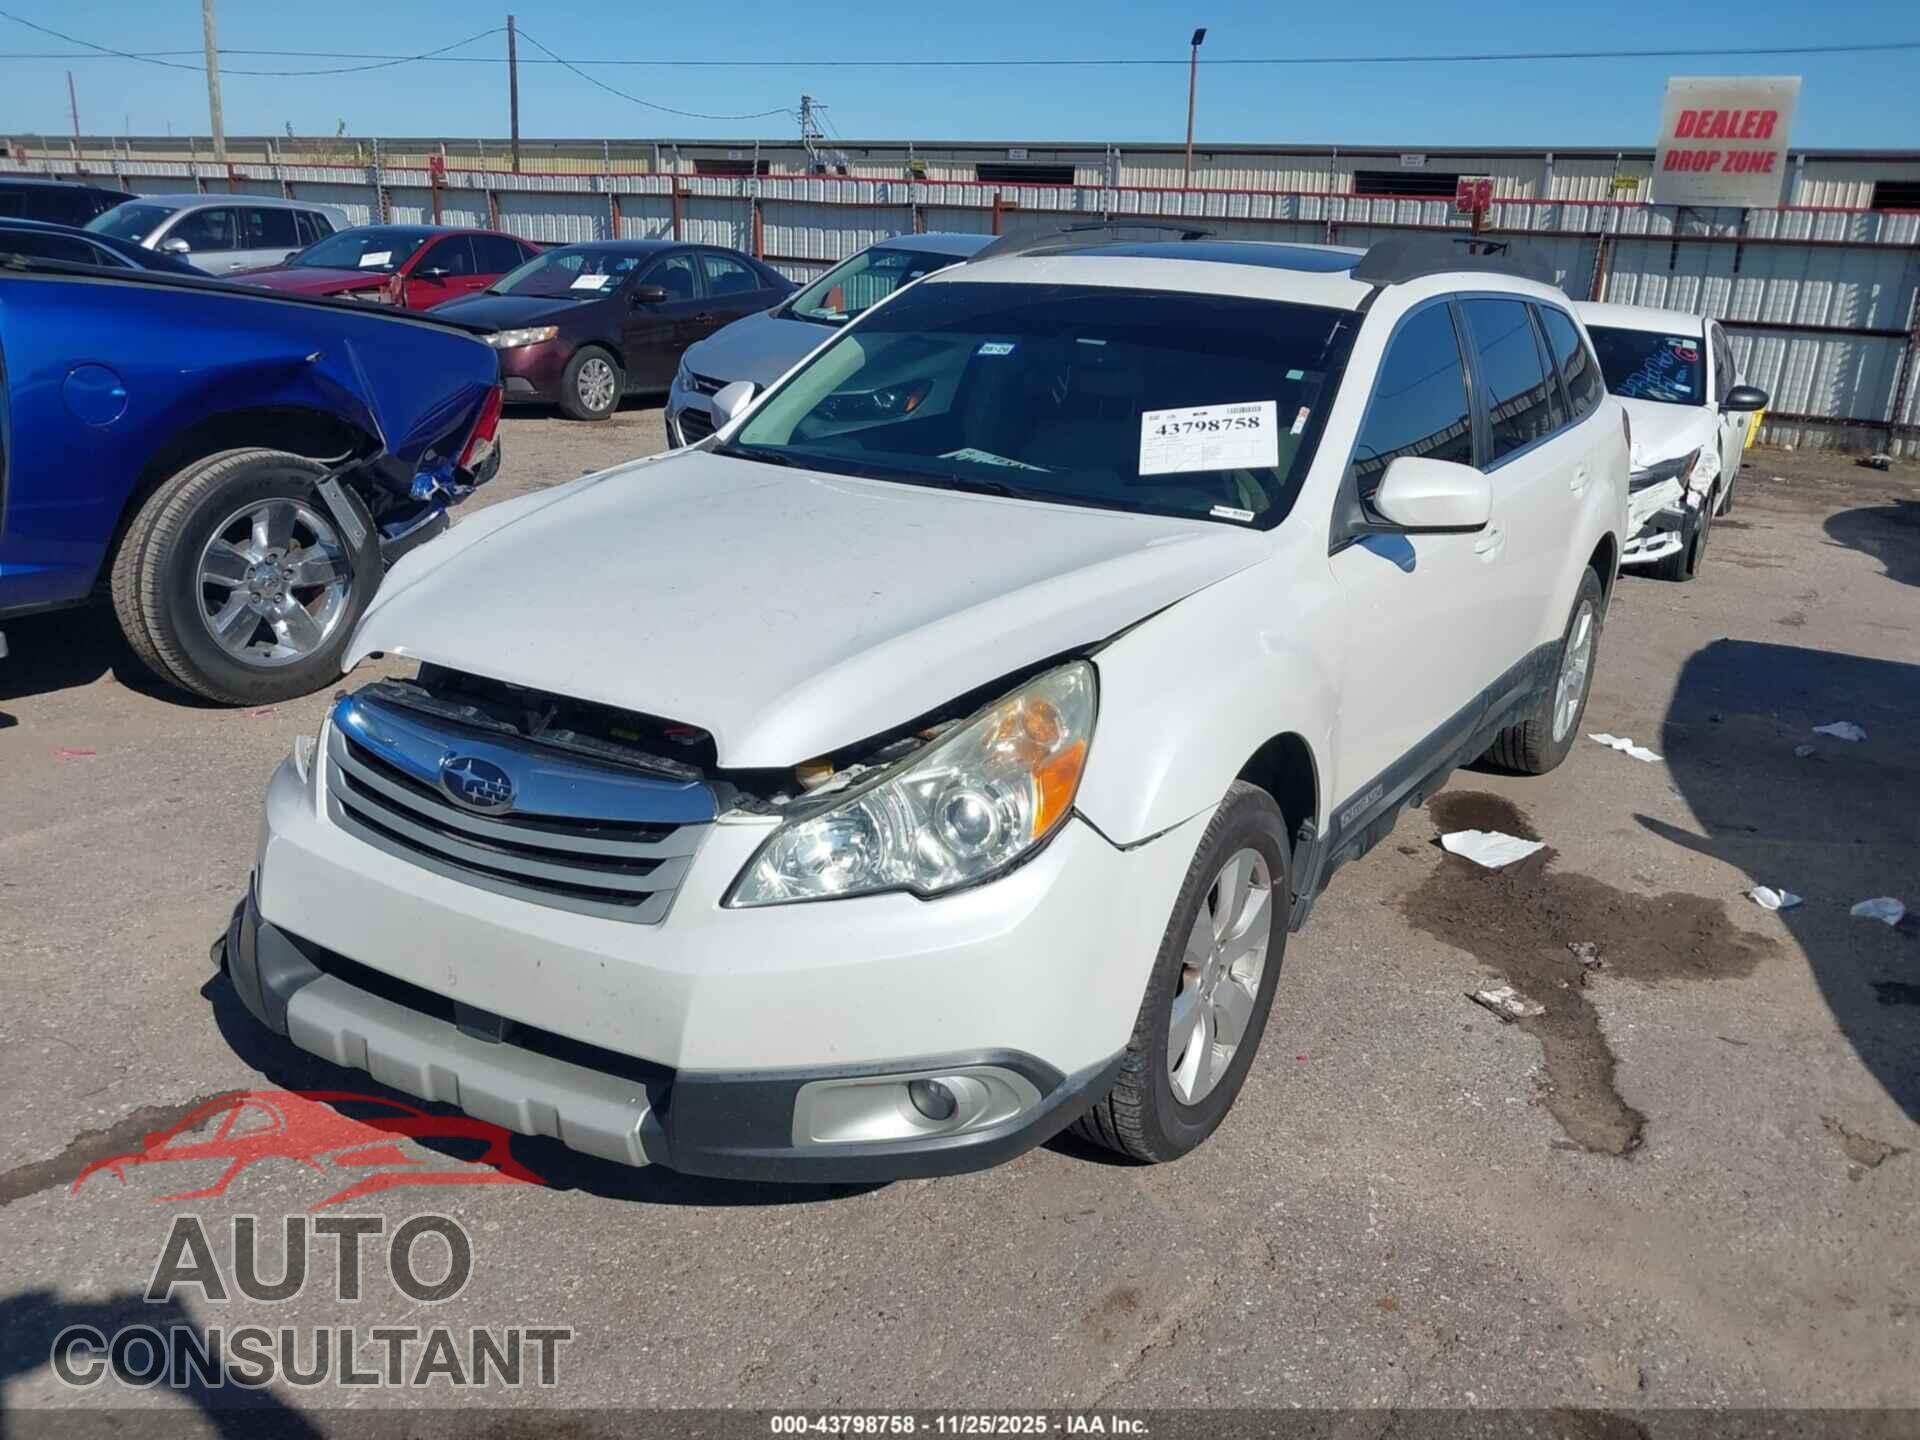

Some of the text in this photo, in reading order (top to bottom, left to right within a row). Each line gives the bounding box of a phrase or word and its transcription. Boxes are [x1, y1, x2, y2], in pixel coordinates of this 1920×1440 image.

[1674, 110, 1778, 139] DEALER
[1663, 149, 1778, 173] DROP ZONE
[1155, 416, 1261, 436] 43798758
